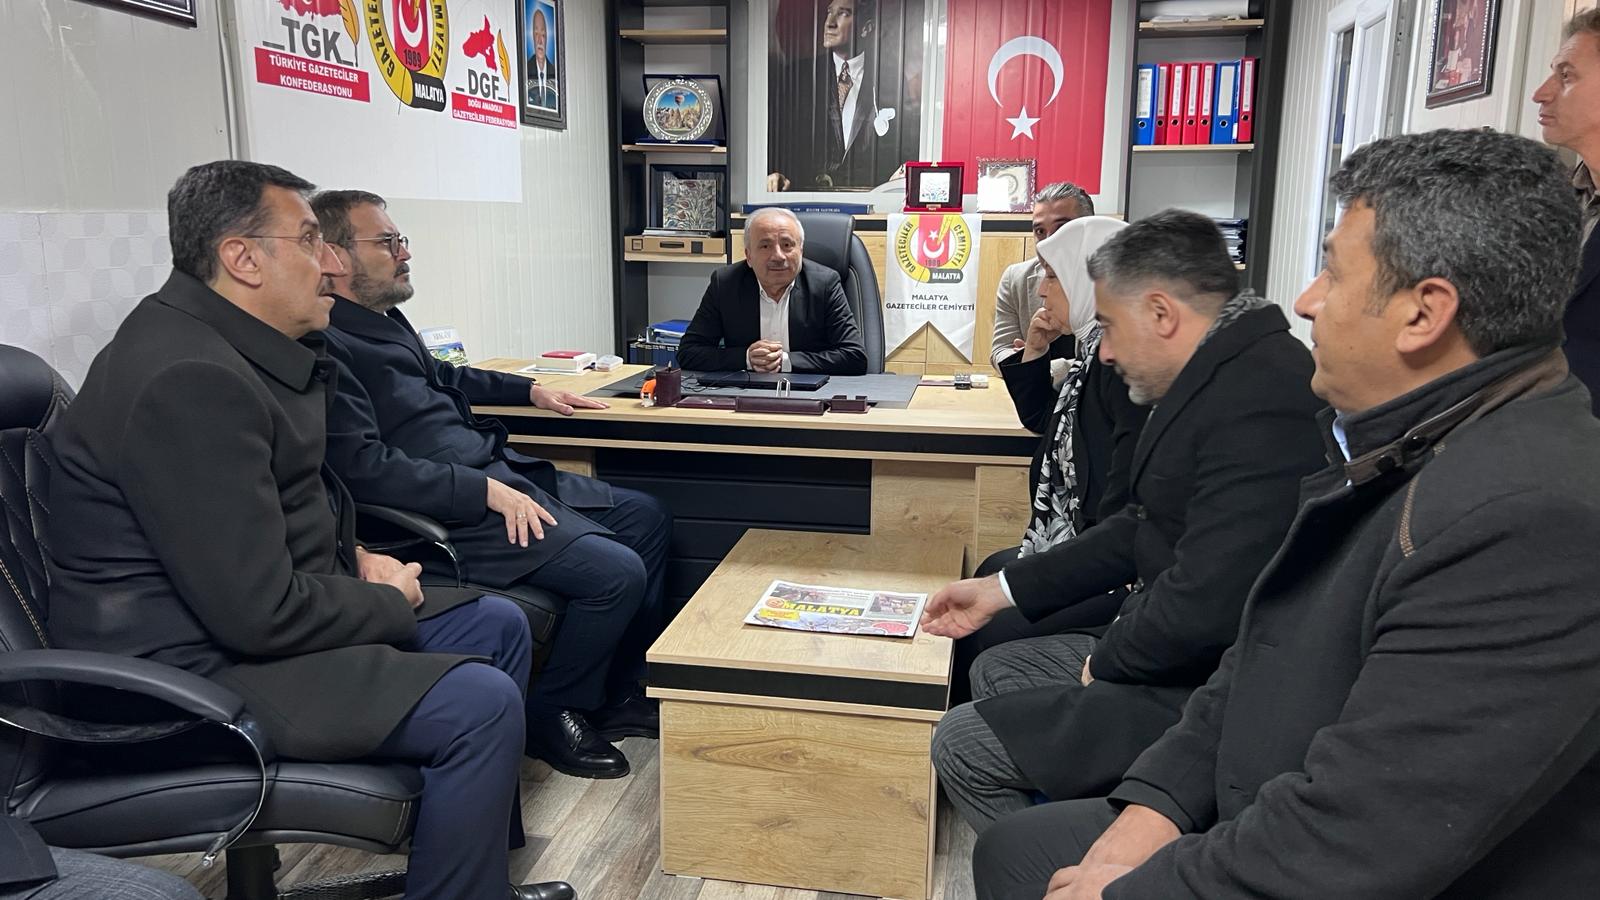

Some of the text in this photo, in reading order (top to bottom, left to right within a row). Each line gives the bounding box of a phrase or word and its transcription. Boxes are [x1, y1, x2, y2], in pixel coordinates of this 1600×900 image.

[268, 54, 359, 83] TÜRKİYE GAZETECİLER
[279, 74, 353, 98] KONFEDERASYONU
[414, 82, 445, 104] MALATYA
[482, 101, 503, 113] ANADOLU
[931, 272, 961, 281] MALATYA
[885, 302, 975, 311] GAZETECİLER CEMİYETİ
[783, 601, 861, 617] MALATYA
